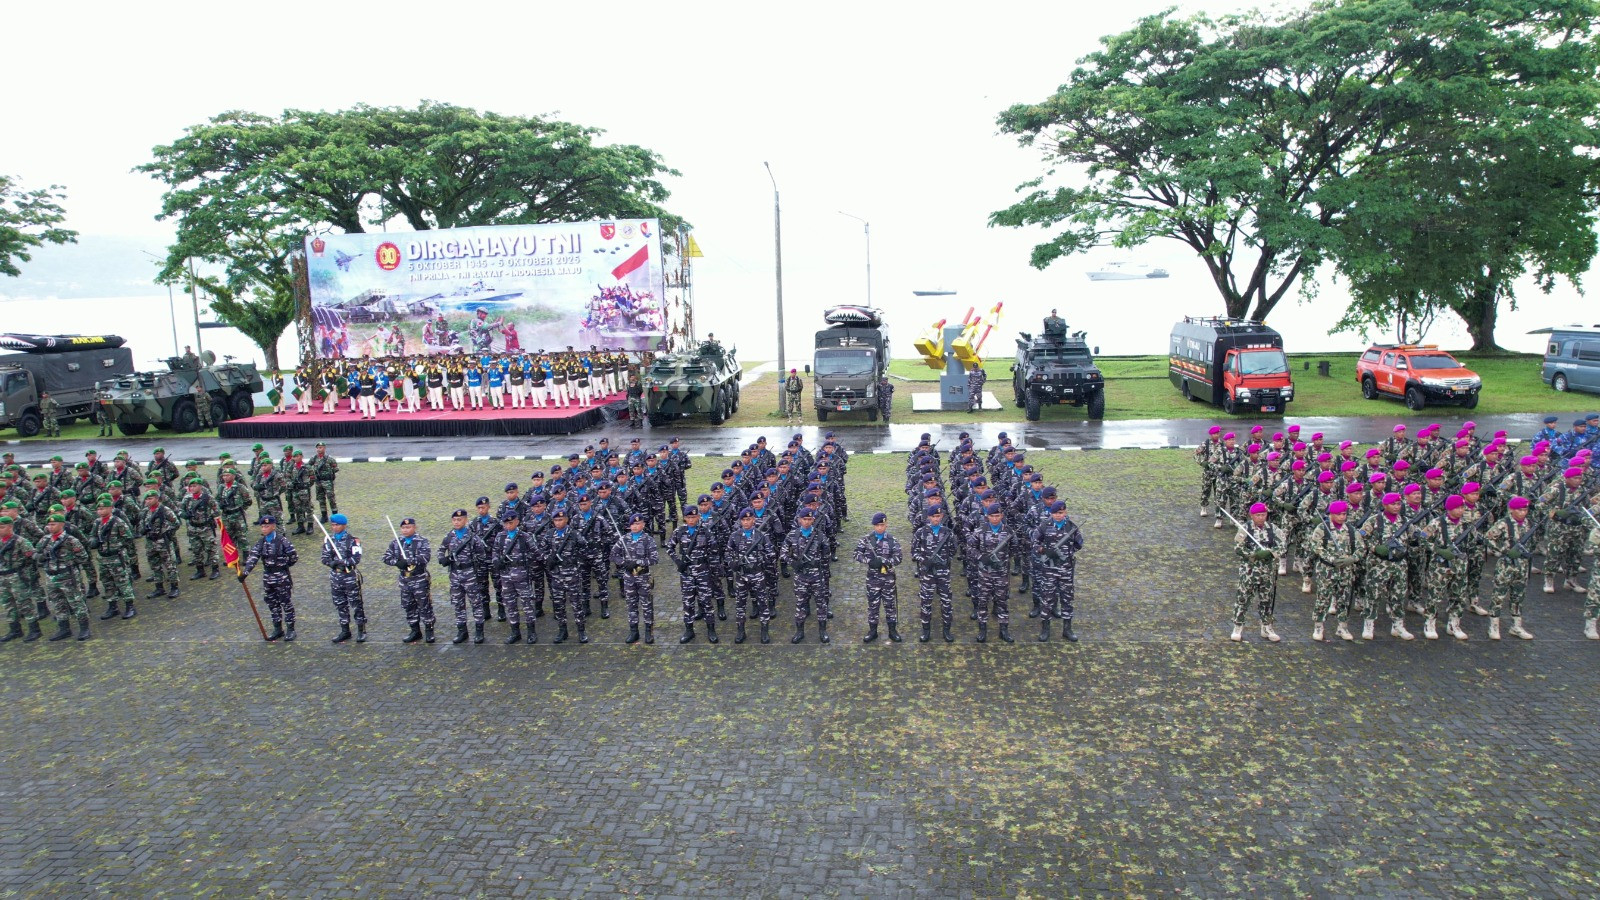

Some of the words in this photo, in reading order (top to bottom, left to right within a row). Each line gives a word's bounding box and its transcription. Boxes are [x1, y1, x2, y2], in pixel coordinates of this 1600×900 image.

[407, 235, 536, 261] DIRGAHAYU
[541, 232, 582, 254] TNI
[408, 262, 415, 271] 5
[417, 260, 461, 271] OKTOBER
[465, 258, 488, 269] 1945
[498, 258, 505, 267] 5
[507, 255, 553, 268] OKTOBER
[556, 254, 581, 265] 2025
[409, 272, 423, 282] TNI
[424, 271, 450, 281] PRIMA
[457, 270, 471, 280] TNI
[472, 268, 503, 279] RAKYAT
[511, 266, 556, 277] INDONESIA
